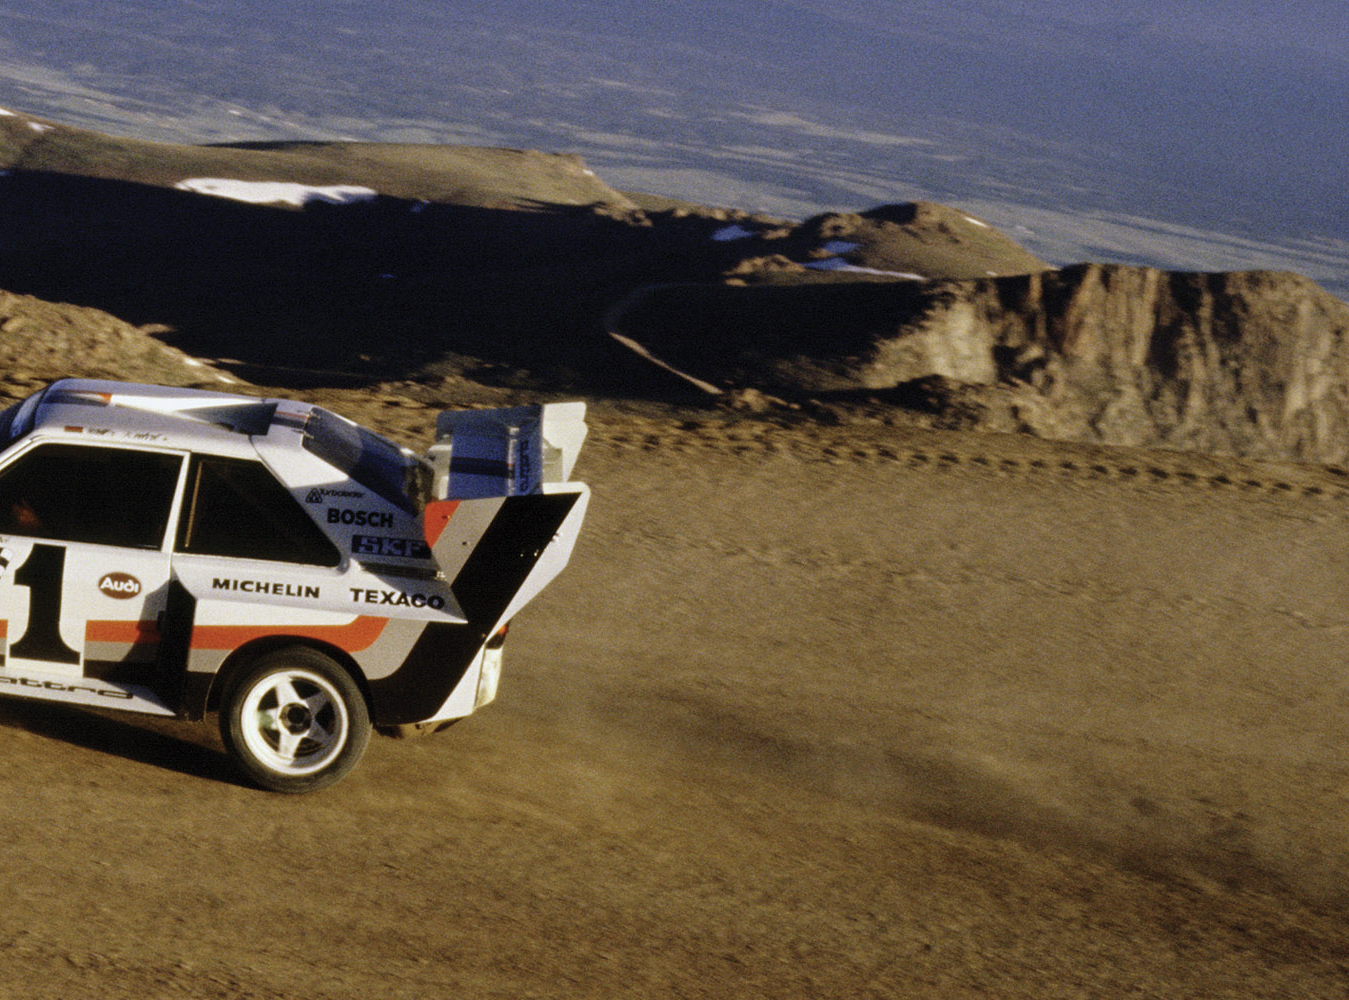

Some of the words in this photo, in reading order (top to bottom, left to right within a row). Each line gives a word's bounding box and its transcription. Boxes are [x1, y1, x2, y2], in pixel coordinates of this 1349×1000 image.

[327, 508, 394, 528] BOSCH
[357, 535, 426, 558] SKF
[100, 577, 139, 594] Audi
[212, 577, 320, 599] MICHELIN
[9, 543, 80, 665] 1
[350, 587, 445, 611] TEXACO
